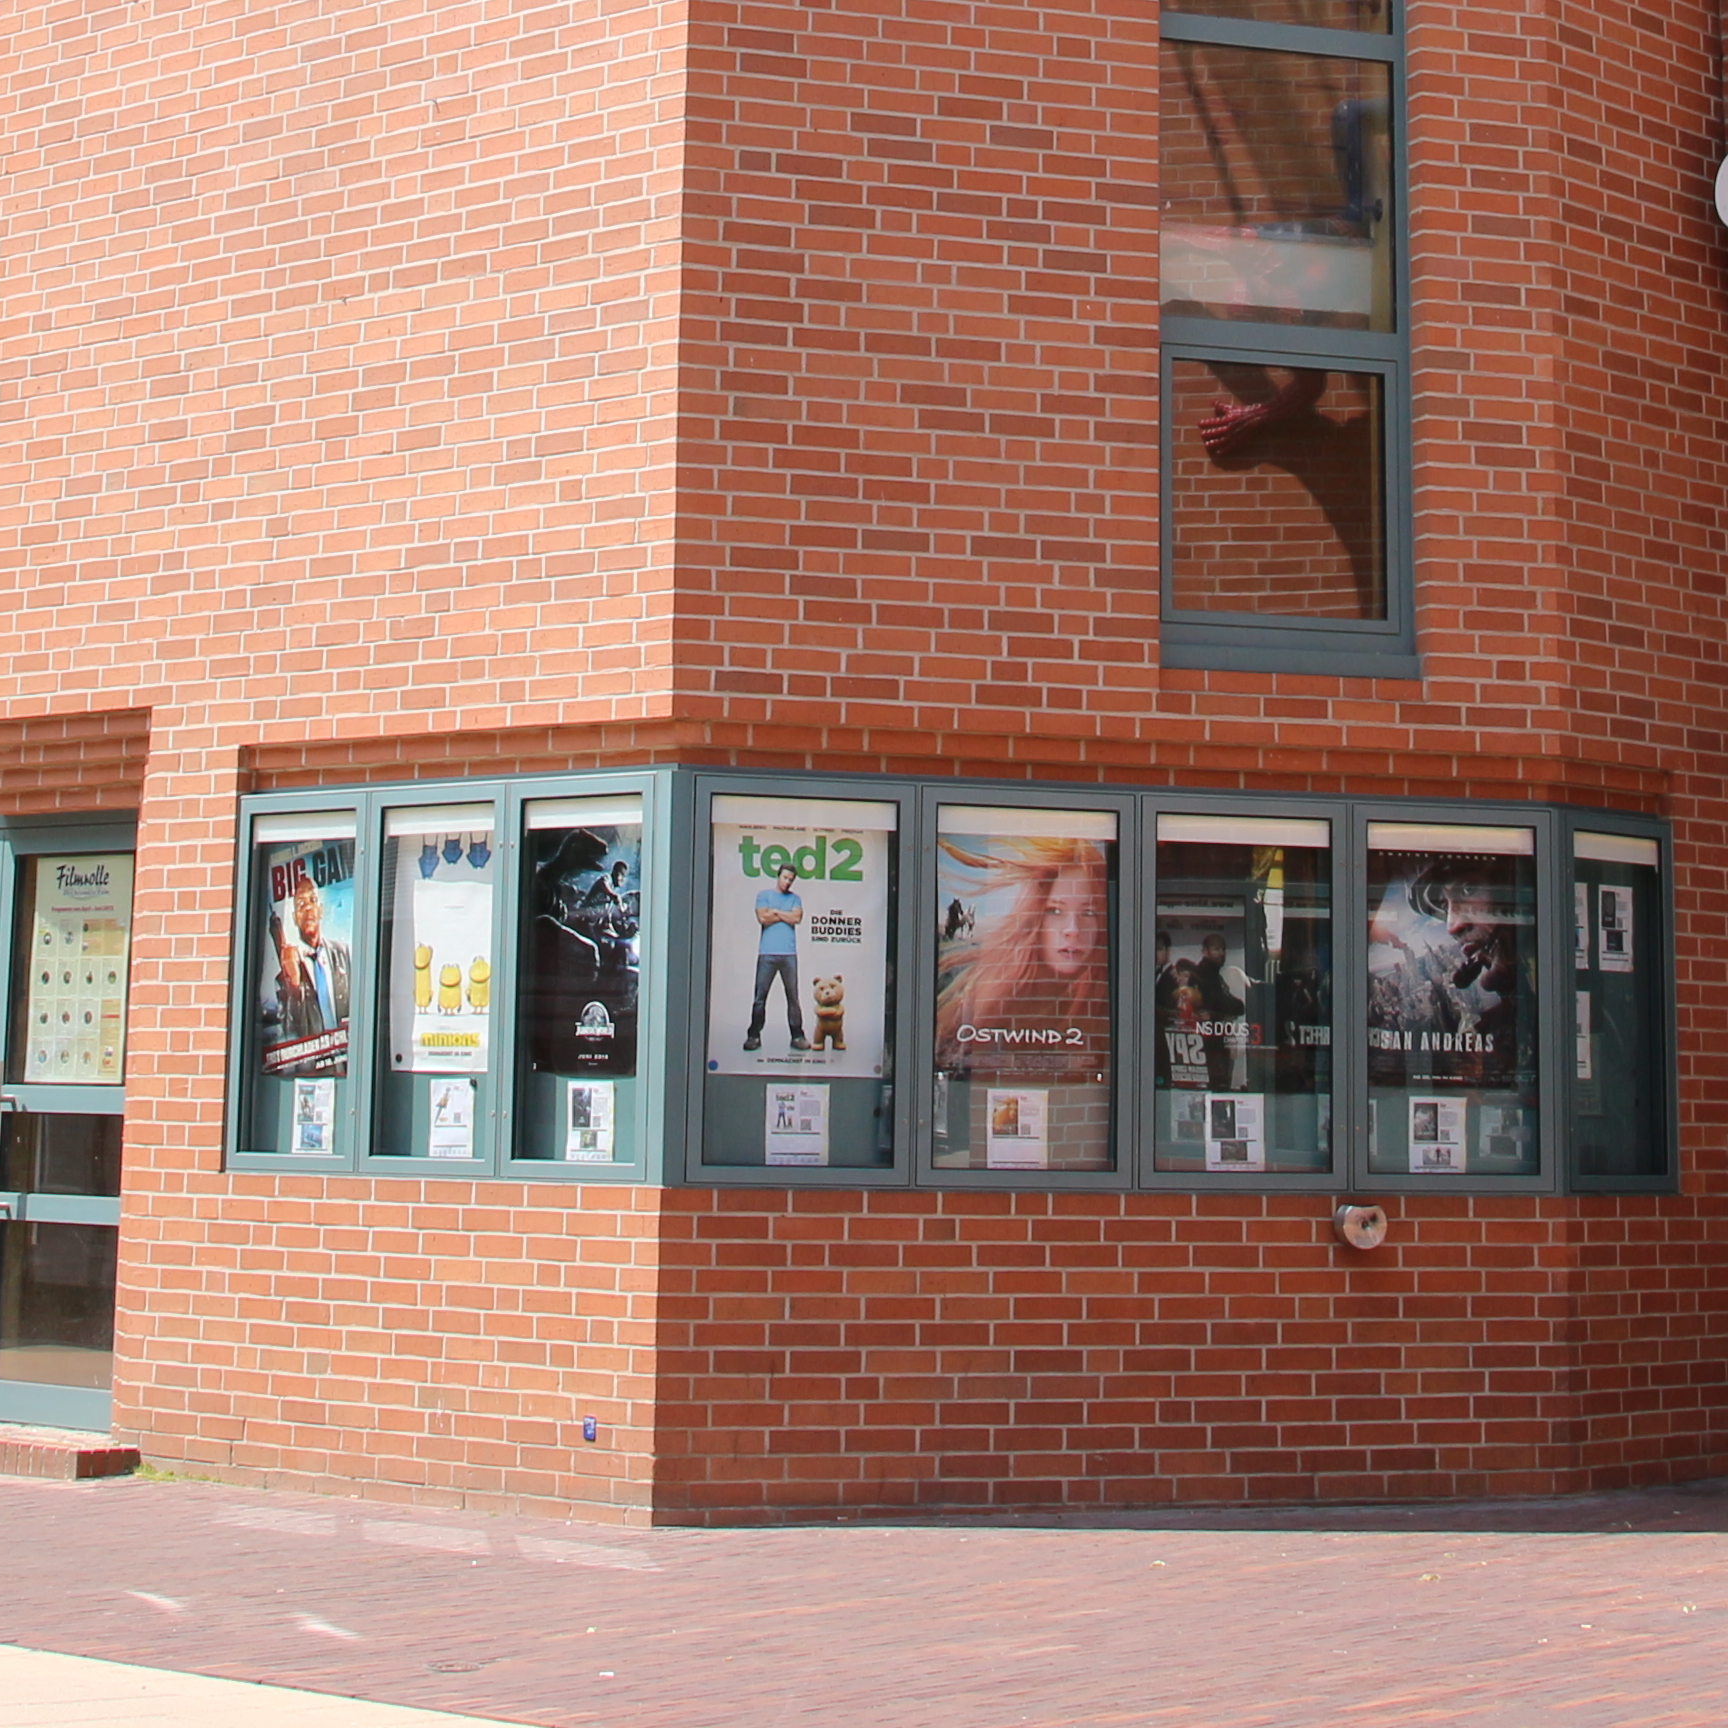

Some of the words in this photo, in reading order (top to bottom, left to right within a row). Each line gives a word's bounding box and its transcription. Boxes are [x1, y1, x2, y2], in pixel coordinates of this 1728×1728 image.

[56, 864, 109, 890] Filmrolle
[272, 858, 306, 902] BIG
[811, 916, 862, 926] DONNER
[811, 926, 862, 936] BUDDIES
[957, 1024, 1062, 1044] OSTWIND
[1065, 1027, 1084, 1045] 2
[1421, 1031, 1494, 1053] ANDREAS
